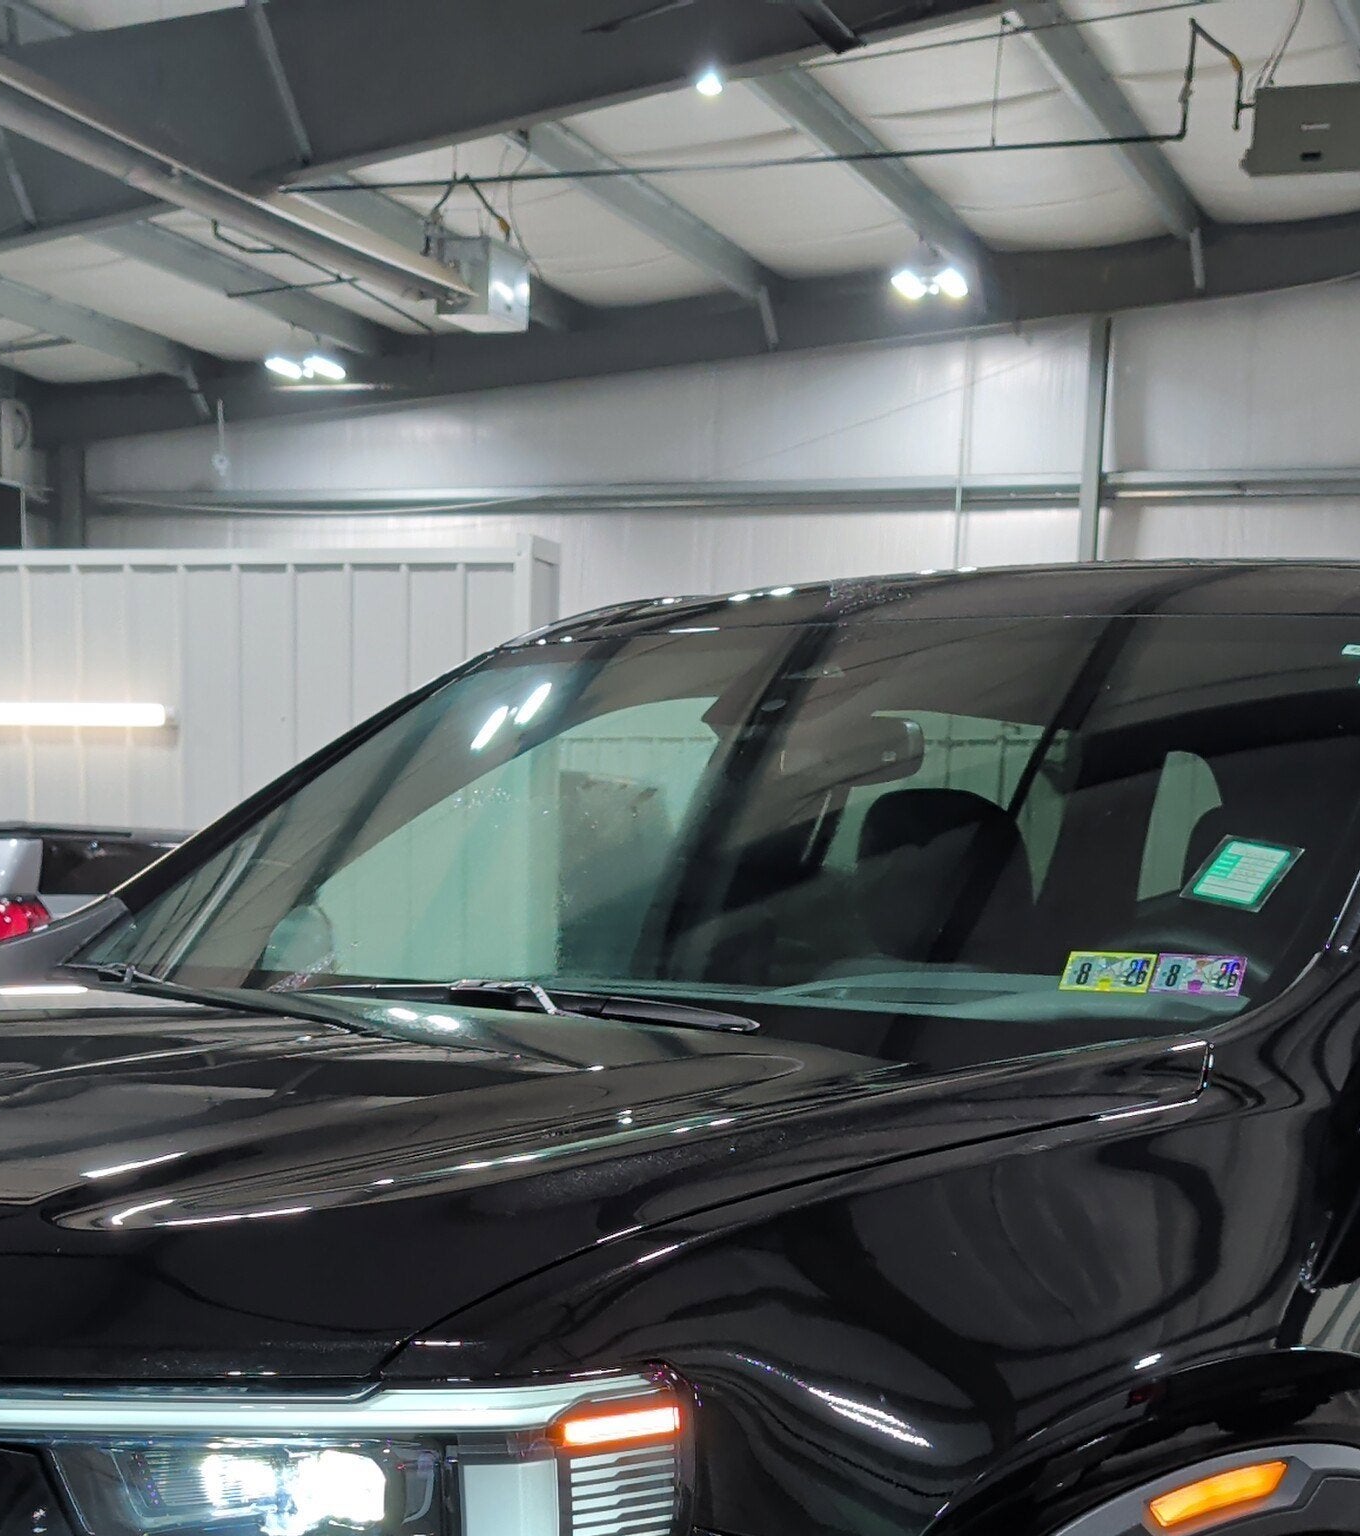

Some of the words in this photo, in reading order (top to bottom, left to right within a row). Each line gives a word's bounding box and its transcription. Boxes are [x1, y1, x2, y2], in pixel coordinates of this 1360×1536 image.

[1076, 962, 1092, 985] 8
[1124, 958, 1151, 987] 26
[1165, 964, 1181, 987] 8
[1215, 960, 1241, 989] 26
